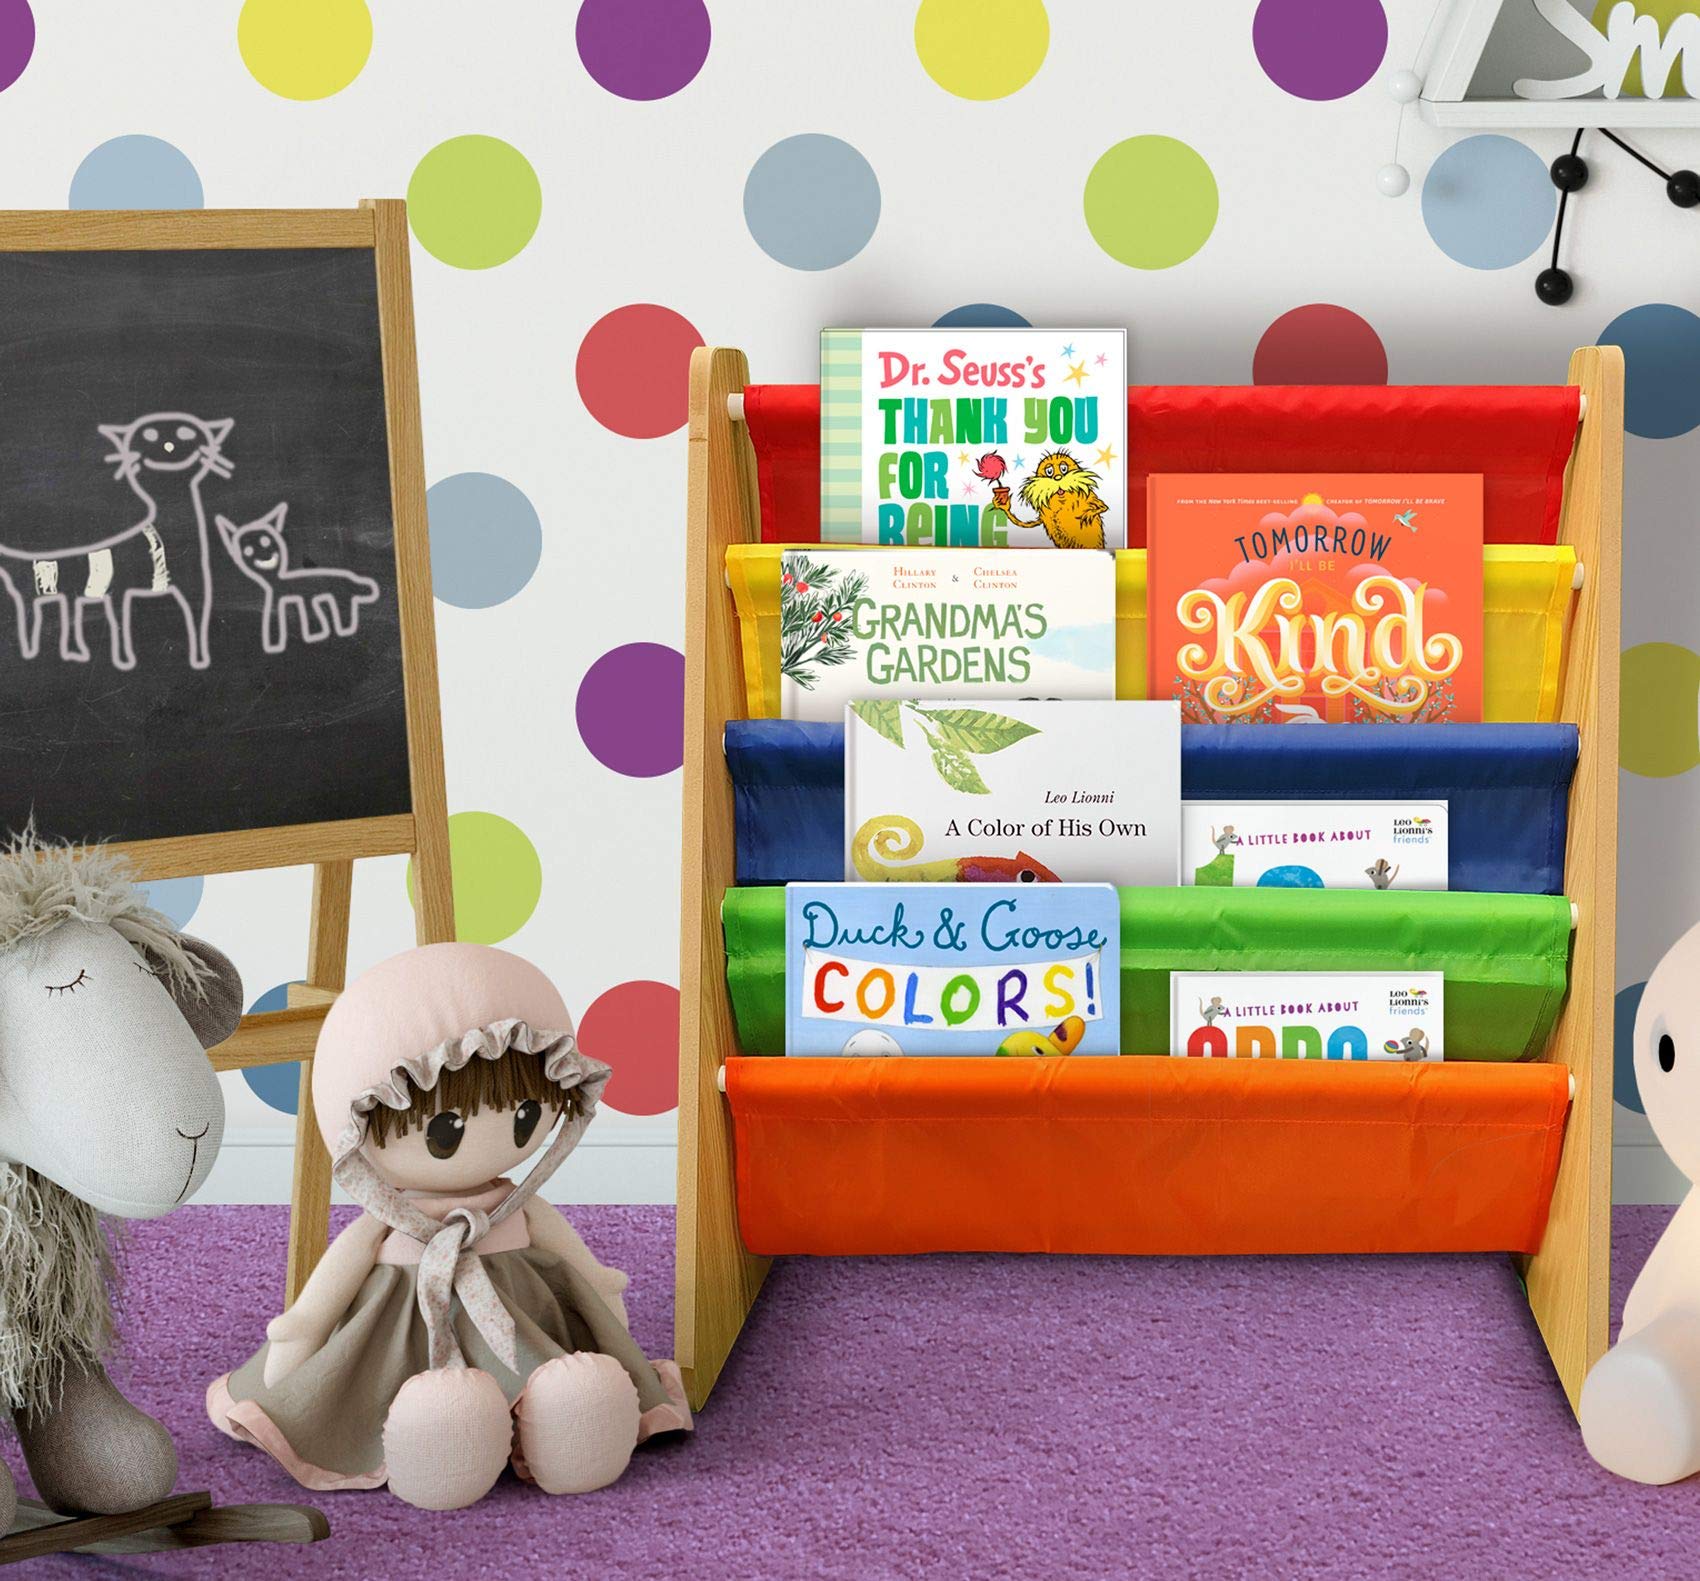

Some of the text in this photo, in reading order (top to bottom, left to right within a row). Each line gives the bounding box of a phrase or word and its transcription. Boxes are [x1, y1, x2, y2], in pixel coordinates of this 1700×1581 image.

[878, 348, 1046, 389] Dr. Seuss's
[878, 396, 1099, 445] THANK YOU
[878, 451, 950, 500] FOR
[1234, 525, 1392, 563] TOMORROW
[952, 574, 960, 583] &
[1289, 559, 1336, 572] I'LL BE
[852, 597, 1048, 641] GRANDMA'S
[1176, 575, 1463, 715] Kind
[866, 642, 1031, 685] GARDENS
[1045, 790, 1115, 804] Leo Lionni
[945, 818, 1147, 837] A Color of His Own
[1393, 818, 1412, 826] Leo
[1236, 829, 1372, 846] A LITTLE BOOK ABOUT
[1393, 835, 1430, 844] friends
[803, 898, 1107, 952] Duck & Goose
[813, 960, 1096, 1027] COLORS!
[1223, 1001, 1359, 1017] A LITTLE BOOK ABOUT
[1389, 1006, 1426, 1016] friends
